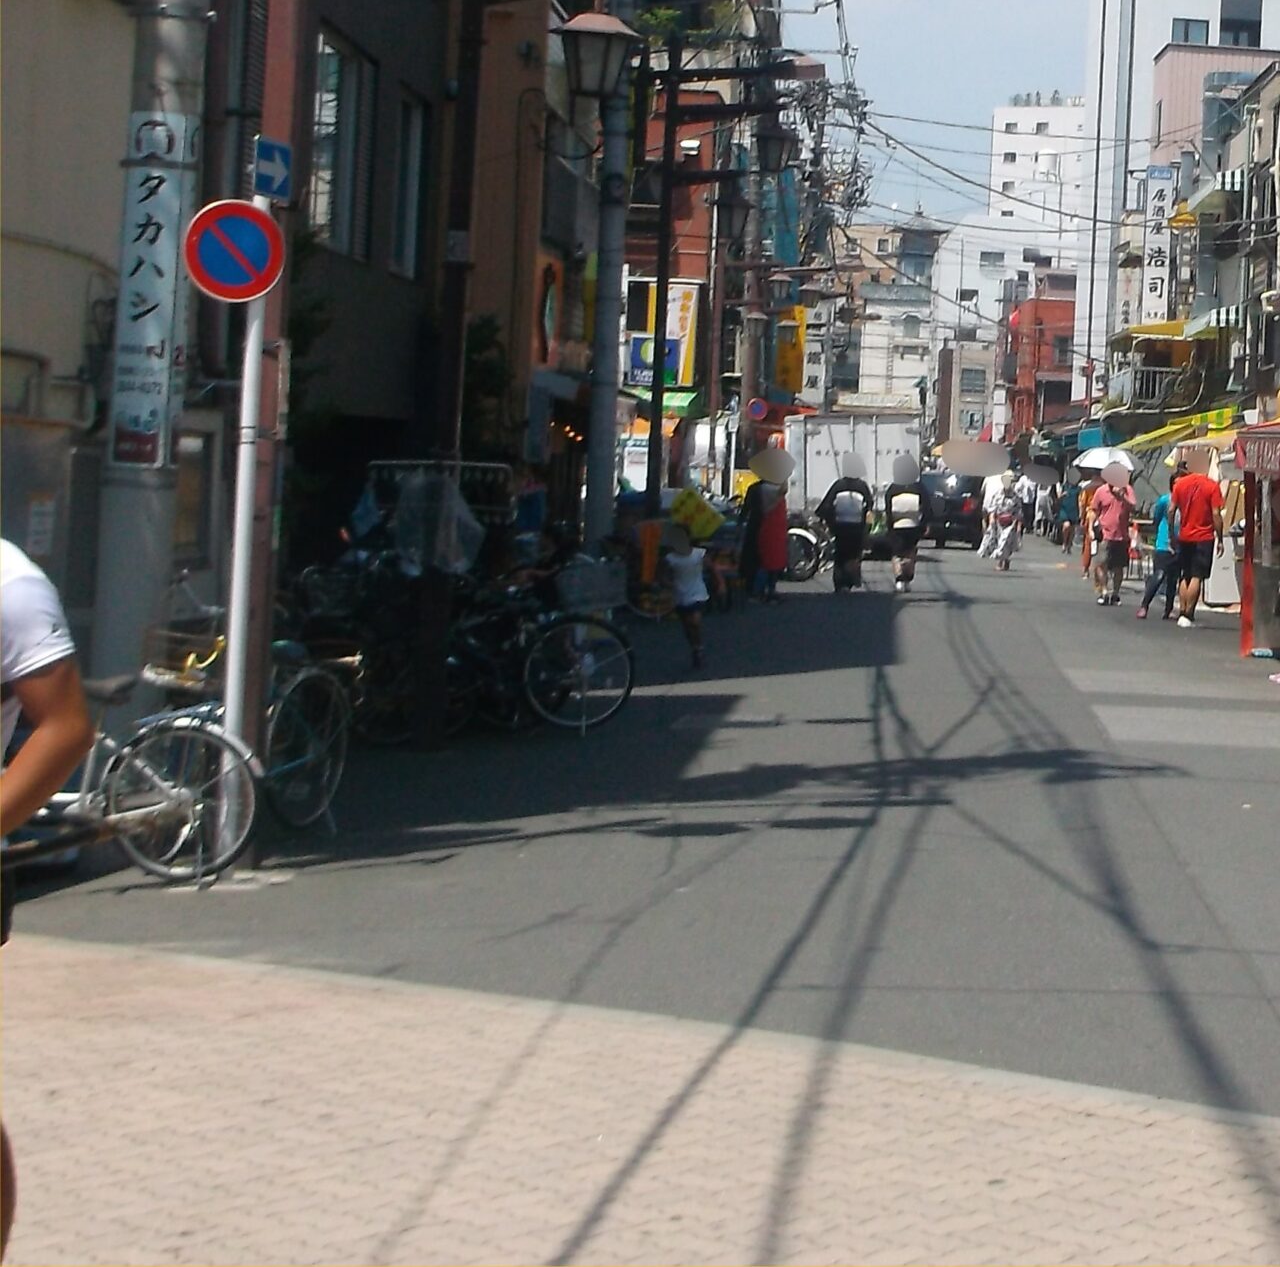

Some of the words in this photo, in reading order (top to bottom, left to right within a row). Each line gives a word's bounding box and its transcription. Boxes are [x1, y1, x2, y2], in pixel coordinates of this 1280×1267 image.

[129, 172, 166, 322] タカハシ
[1146, 245, 1168, 300] 浩司
